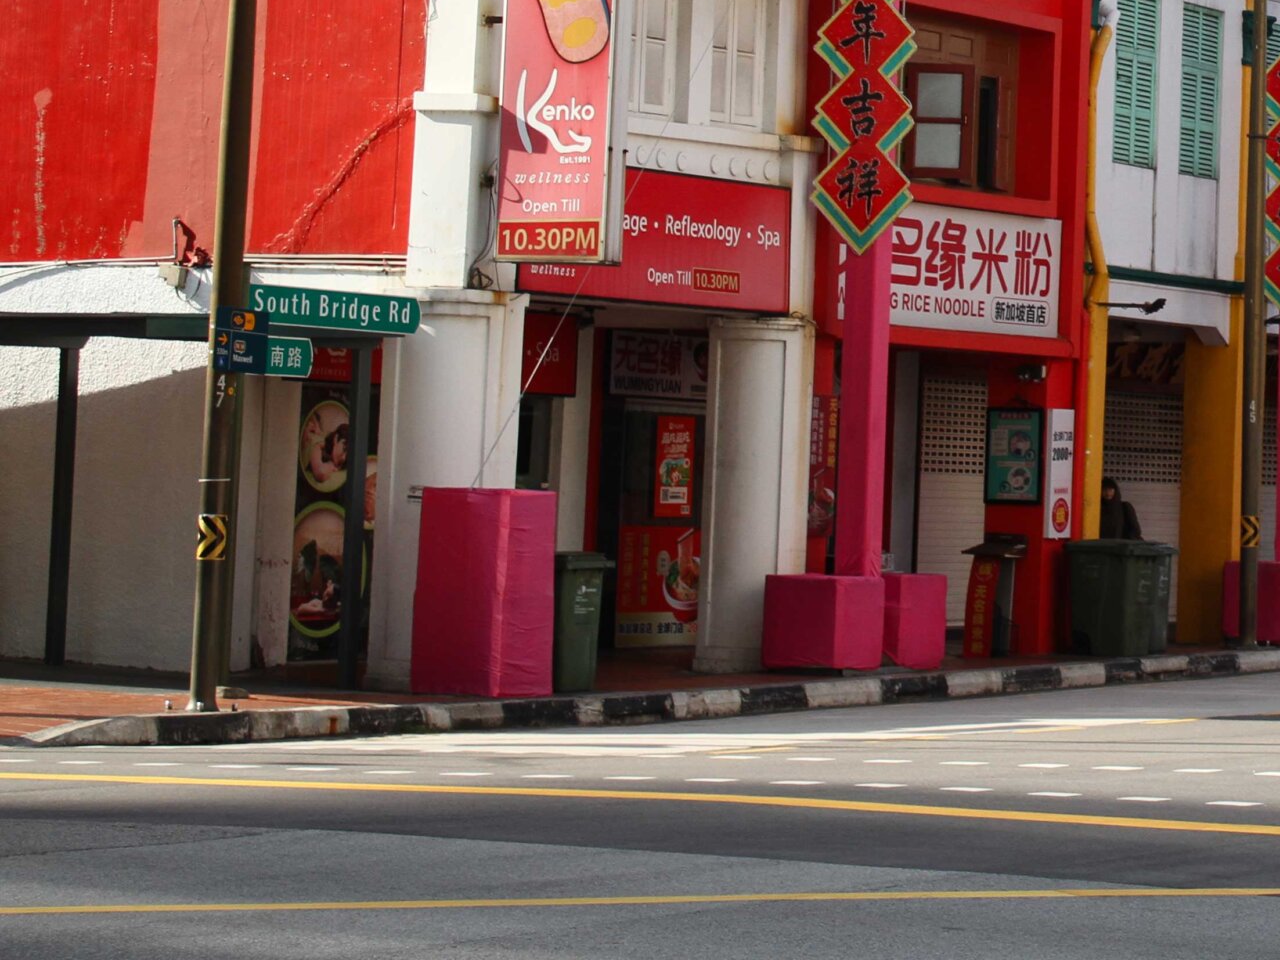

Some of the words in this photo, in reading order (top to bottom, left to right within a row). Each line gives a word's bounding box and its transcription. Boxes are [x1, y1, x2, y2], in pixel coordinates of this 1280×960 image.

[516, 68, 595, 154] Kenko
[559, 155, 592, 165] Est.1991
[515, 171, 590, 184] wellness
[522, 199, 557, 215] Open
[561, 198, 580, 212] Till
[502, 227, 596, 251] 10.30PM
[665, 214, 741, 247] Reflexology
[757, 225, 781, 251] Spa
[530, 264, 576, 277] wellness
[647, 268, 674, 285] Open
[676, 270, 692, 286] Till
[695, 272, 739, 291] 10.30PM
[254, 288, 310, 316] South
[319, 294, 381, 326] Bridge
[389, 300, 411, 324] Rd
[902, 293, 930, 313] RICE
[935, 296, 985, 318] NOODLE
[995, 300, 1047, 324] 新加坡首店
[535, 341, 560, 367] Spa
